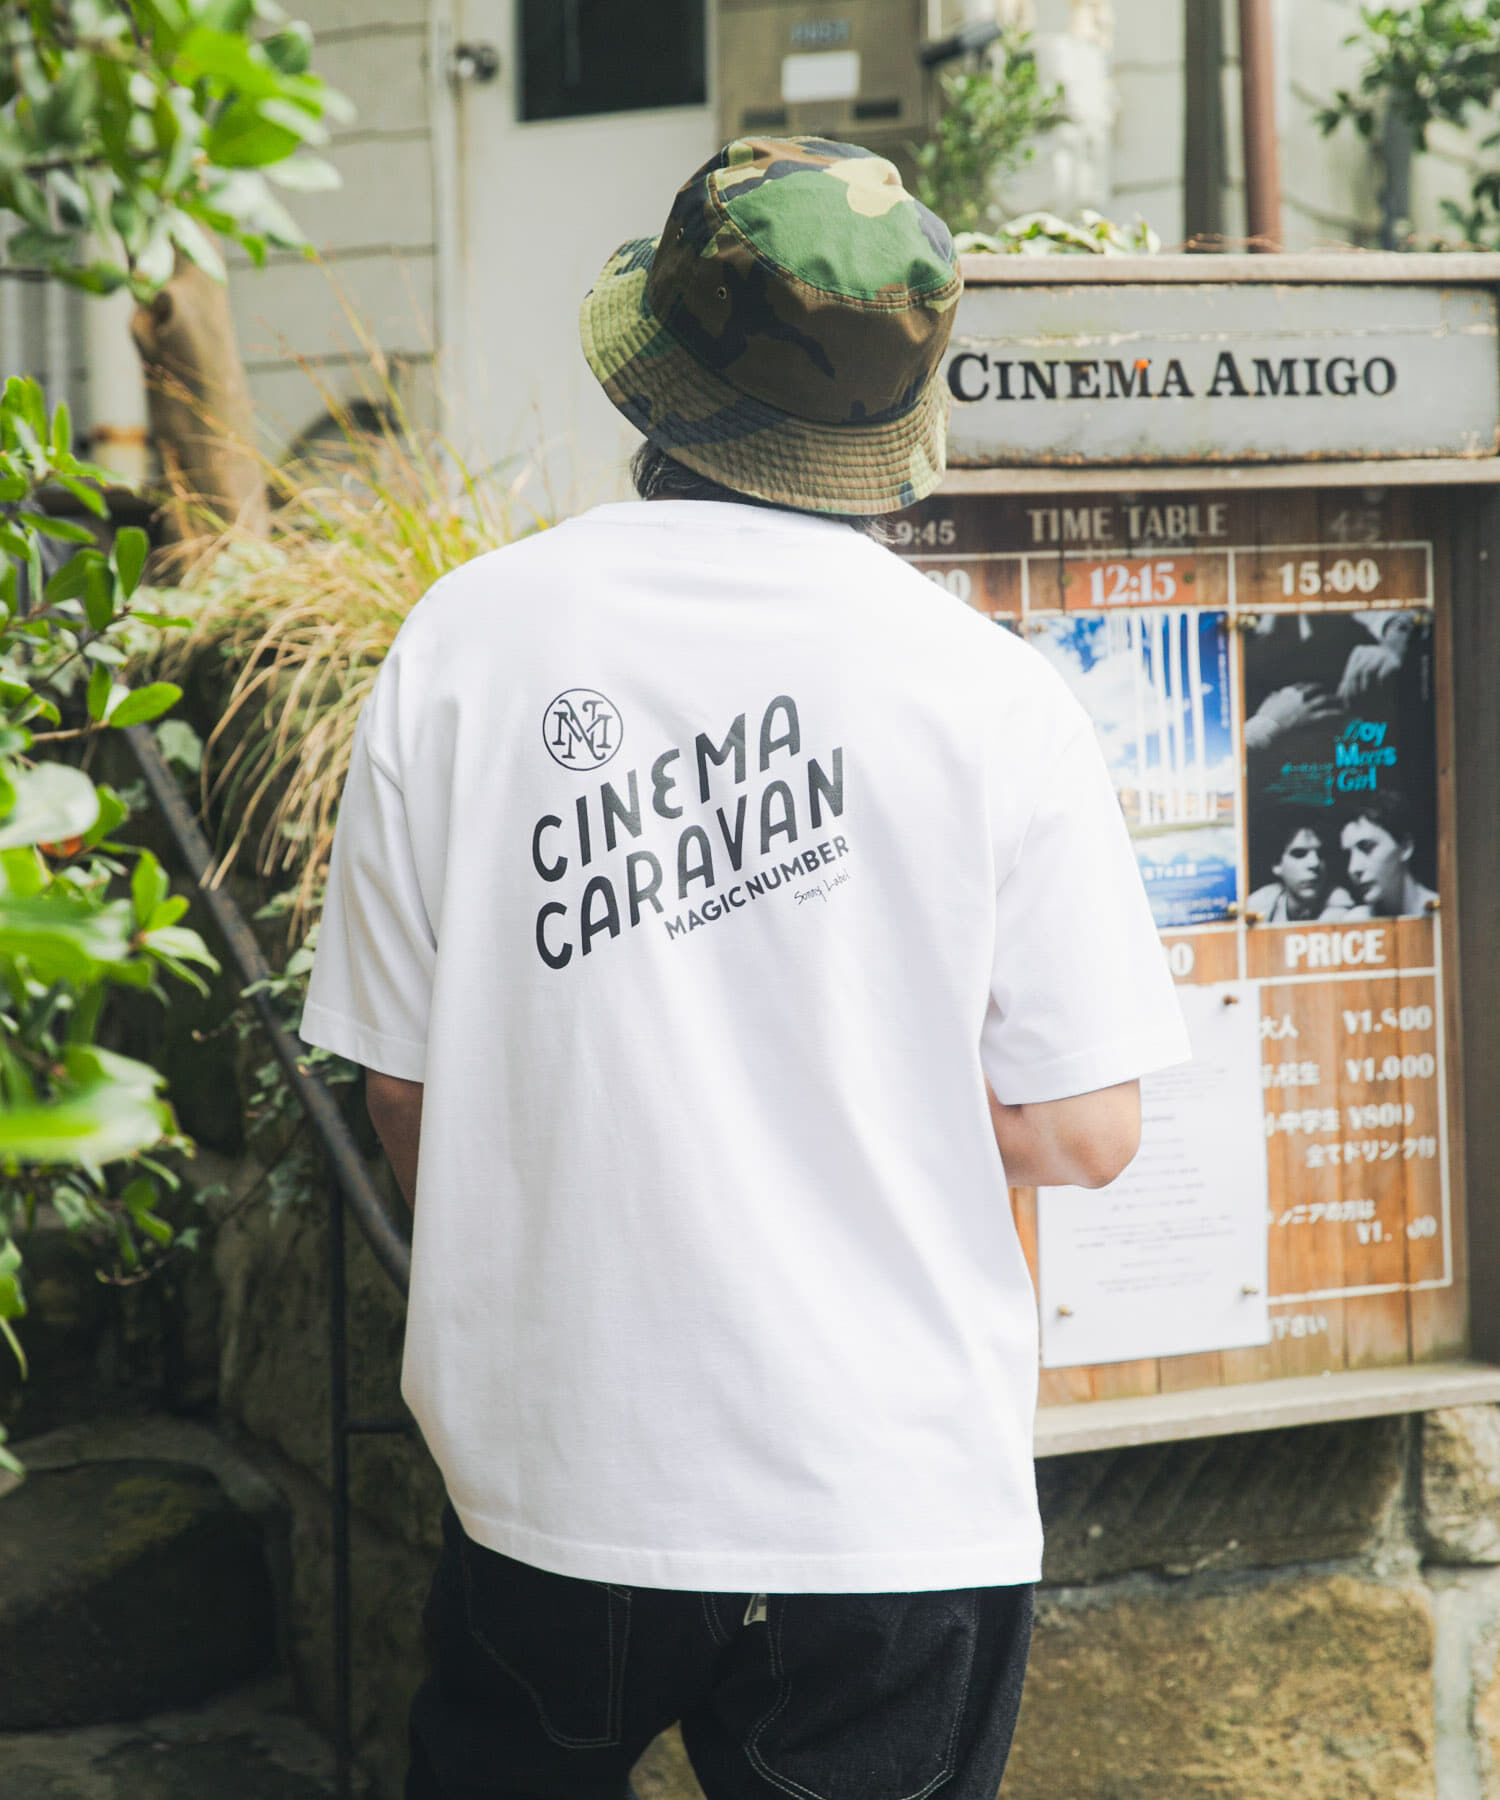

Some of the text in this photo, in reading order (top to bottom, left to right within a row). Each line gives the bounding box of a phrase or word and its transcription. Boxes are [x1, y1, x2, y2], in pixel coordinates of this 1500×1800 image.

[947, 350, 1398, 402] CINEMA AMIGO
[1027, 504, 1228, 542] TIME TABLE
[1089, 562, 1177, 606] 12:15
[1277, 559, 1381, 596] 15:00
[532, 694, 801, 882] CINEMA
[535, 746, 844, 969] CARAVAN
[1283, 929, 1387, 969] PRICE
